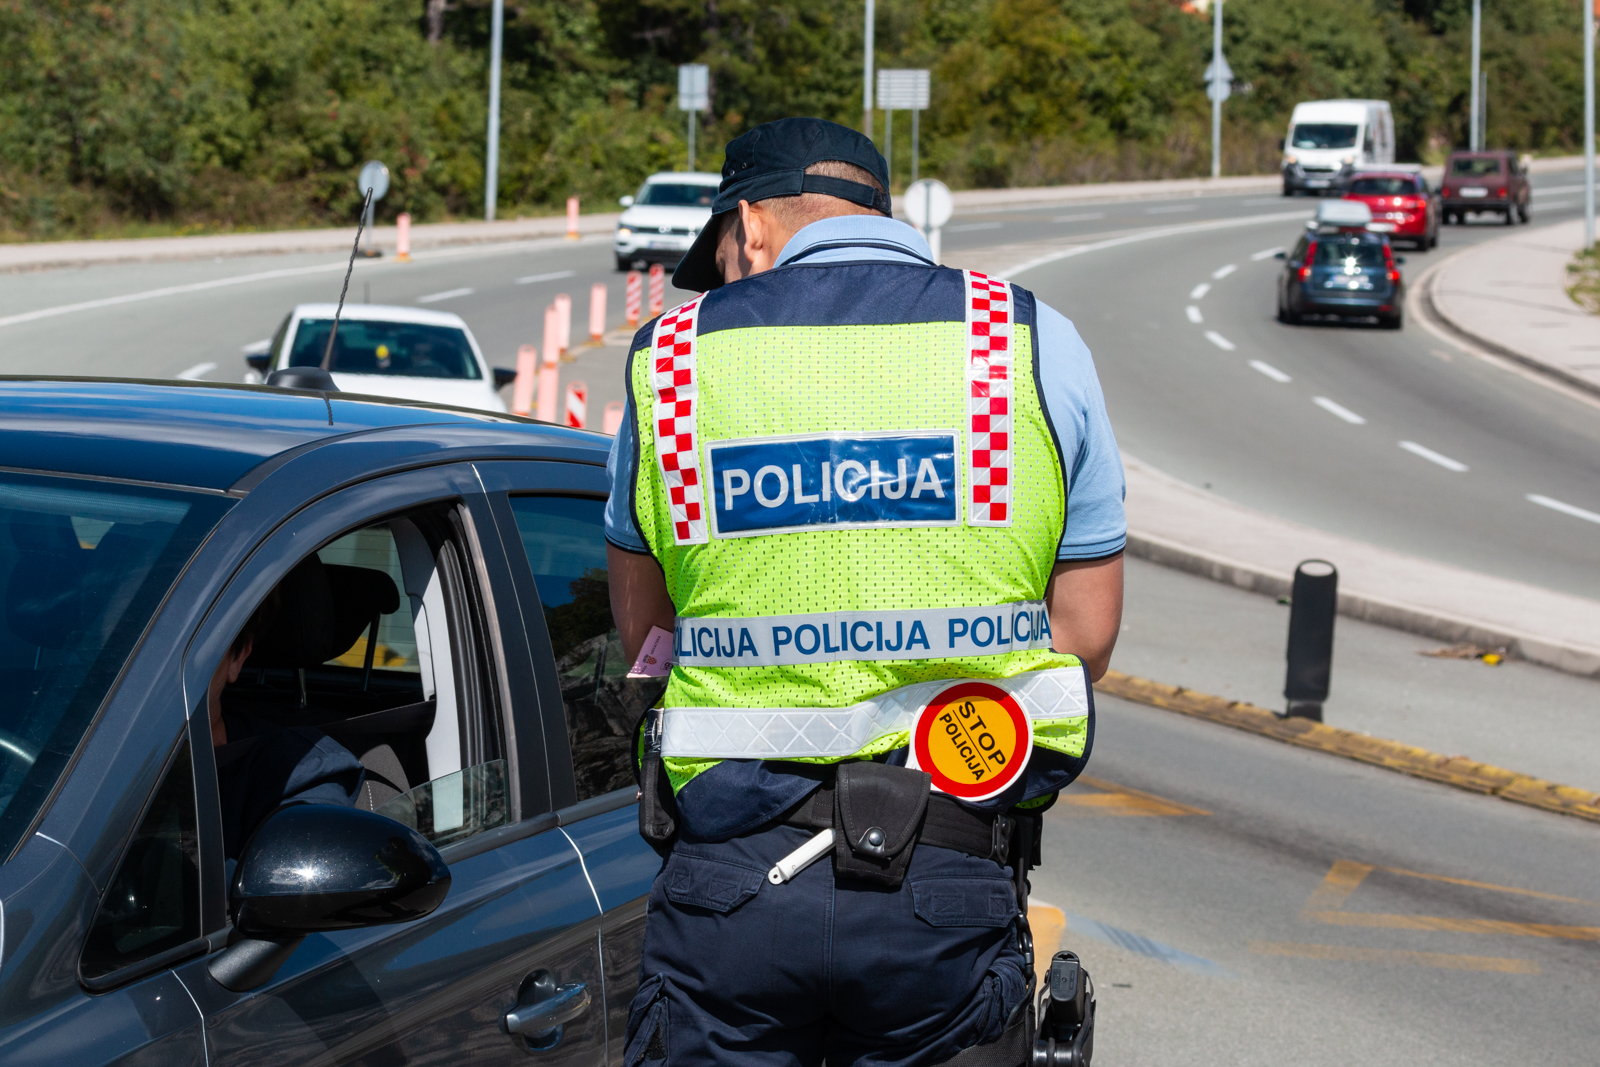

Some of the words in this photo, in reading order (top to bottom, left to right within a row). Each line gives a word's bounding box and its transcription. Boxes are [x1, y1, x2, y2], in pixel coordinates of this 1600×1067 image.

[723, 458, 945, 511] POLICIJA
[772, 620, 930, 656] POLICIJA
[948, 610, 1052, 648] POLICIJA
[939, 713, 985, 781] POLICIJA
[959, 701, 1006, 765] STOP
